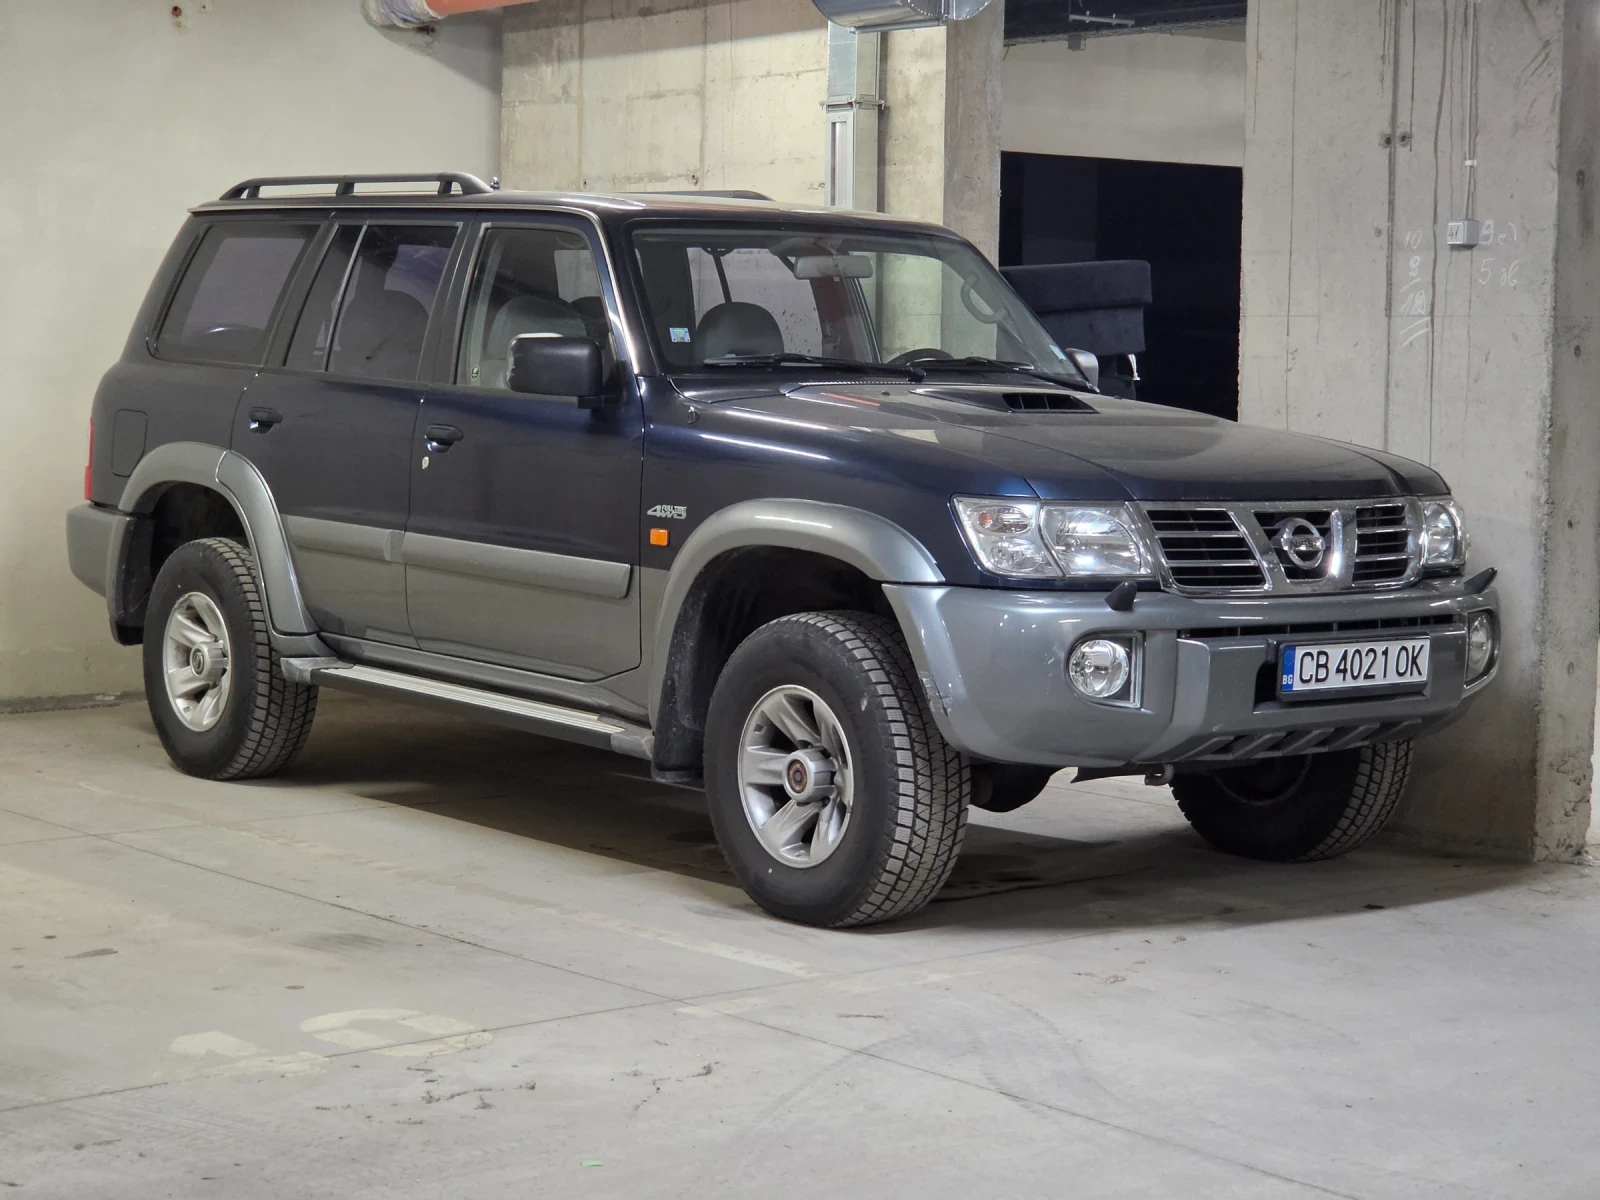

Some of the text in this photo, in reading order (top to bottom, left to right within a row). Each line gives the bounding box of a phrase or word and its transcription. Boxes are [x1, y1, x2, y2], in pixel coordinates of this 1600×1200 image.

[1478, 257, 1495, 285] 5
[1289, 539, 1322, 550] NISS
[1299, 645, 1425, 683] CB 4021 OK
[1282, 674, 1293, 685] BG
